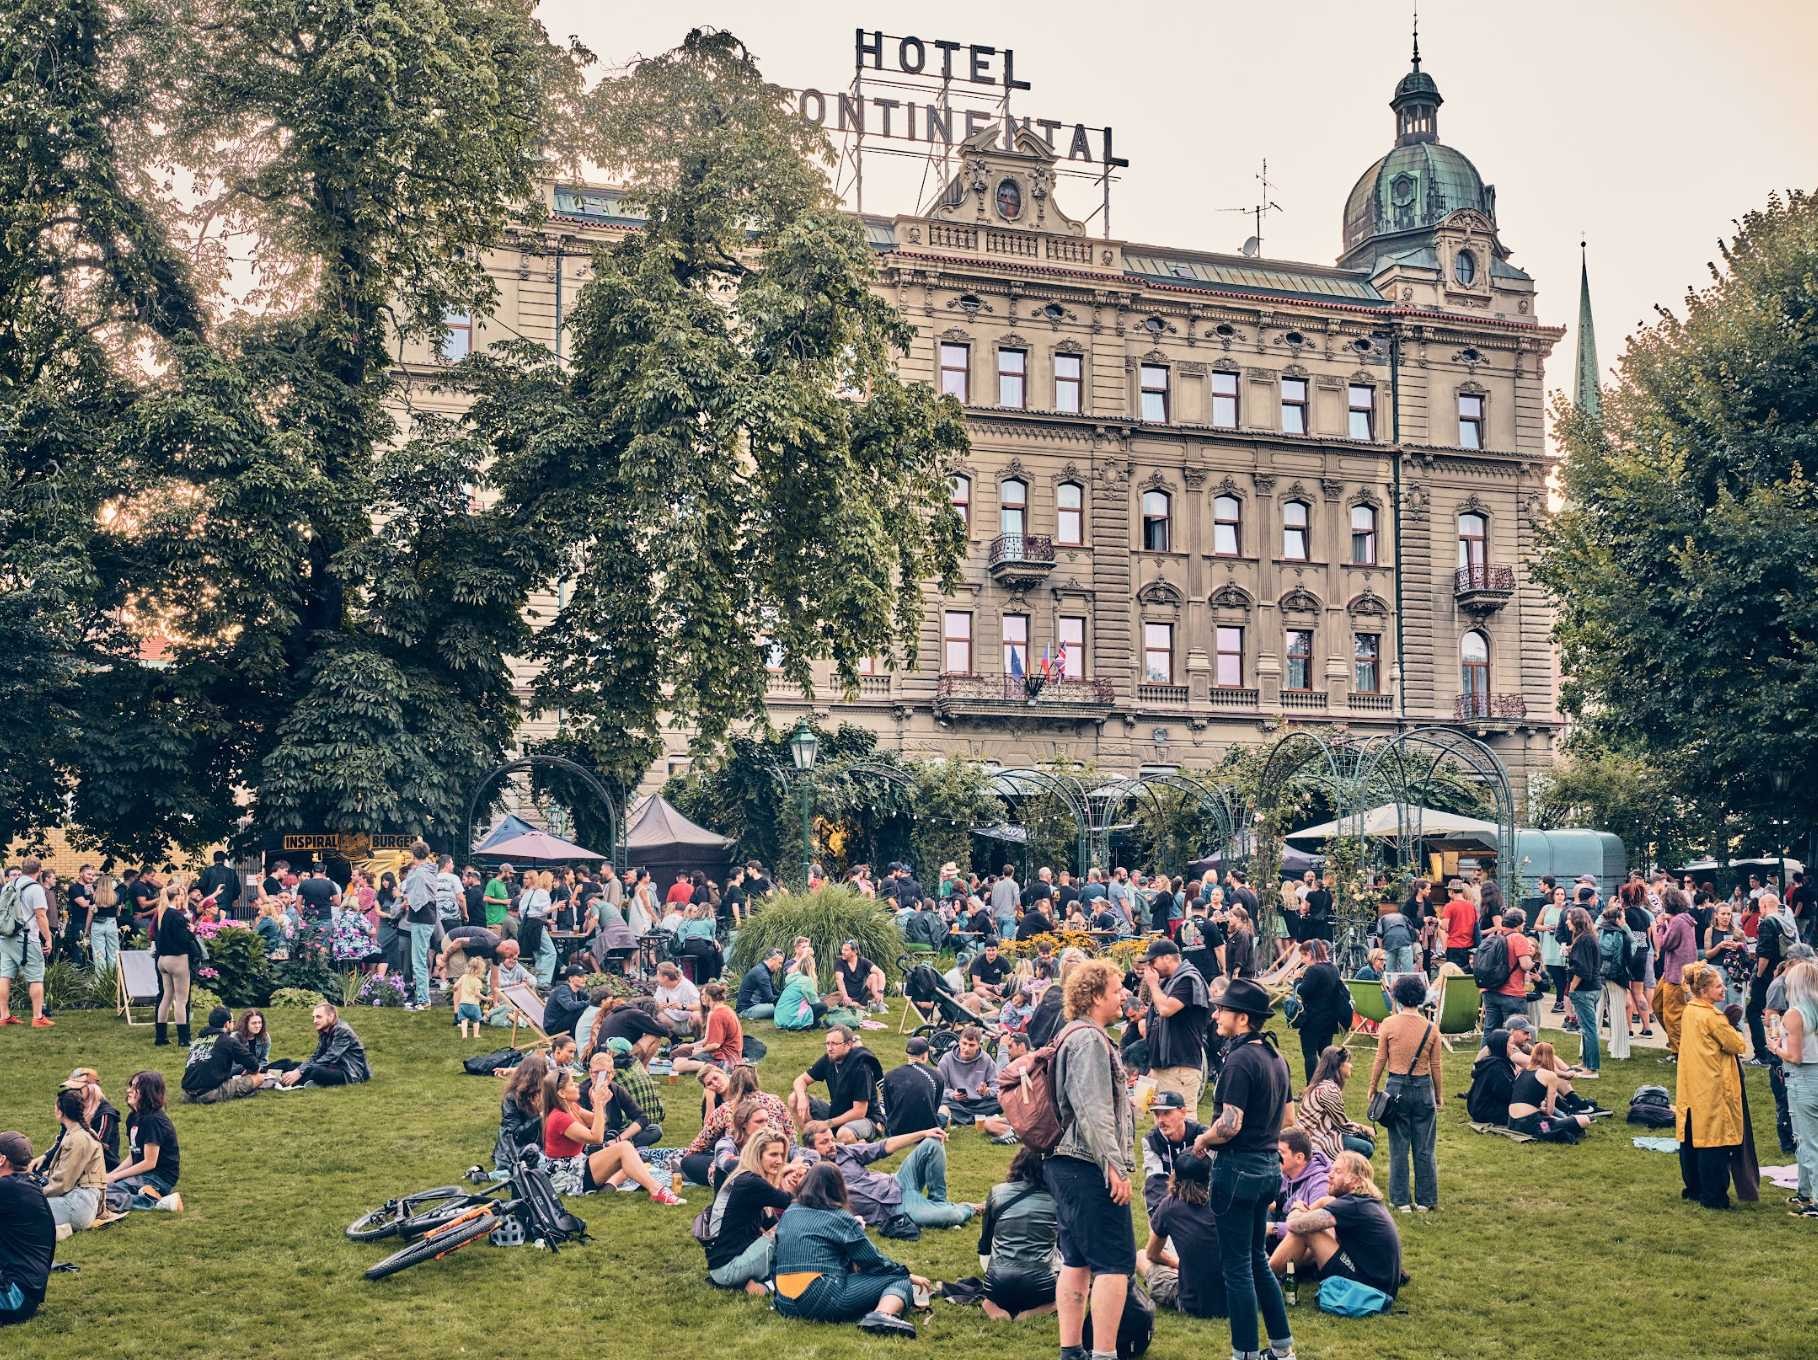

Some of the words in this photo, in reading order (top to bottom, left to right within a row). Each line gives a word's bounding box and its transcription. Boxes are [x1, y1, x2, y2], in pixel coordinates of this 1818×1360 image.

[856, 28, 1031, 91] HOTEL
[765, 82, 1129, 168] ONTINENTAL
[285, 835, 337, 849] INSPIRAL
